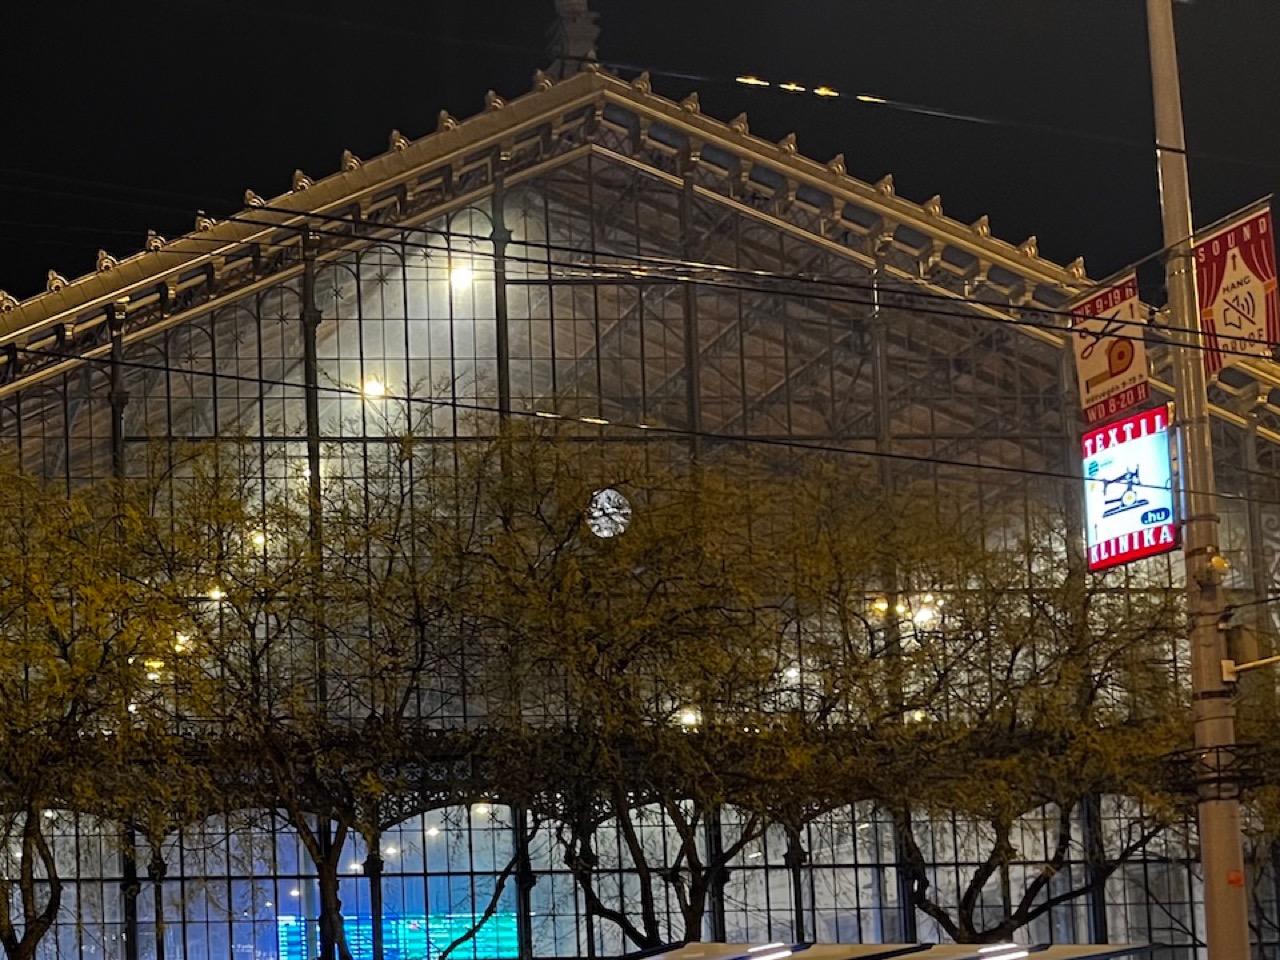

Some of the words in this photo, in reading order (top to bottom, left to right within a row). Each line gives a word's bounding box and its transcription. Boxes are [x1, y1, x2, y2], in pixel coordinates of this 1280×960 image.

[1198, 218, 1268, 263] SOUND
[1095, 289, 1121, 313] 9-19
[1222, 275, 1252, 294] HANG
[1222, 327, 1264, 359] PROOF
[1087, 403, 1106, 422] WD
[1108, 389, 1134, 413] 8-20
[1137, 383, 1146, 400] H
[1084, 414, 1168, 458] TEXTIL
[1143, 508, 1167, 525] .hu
[1090, 525, 1173, 564] KLINIKA
